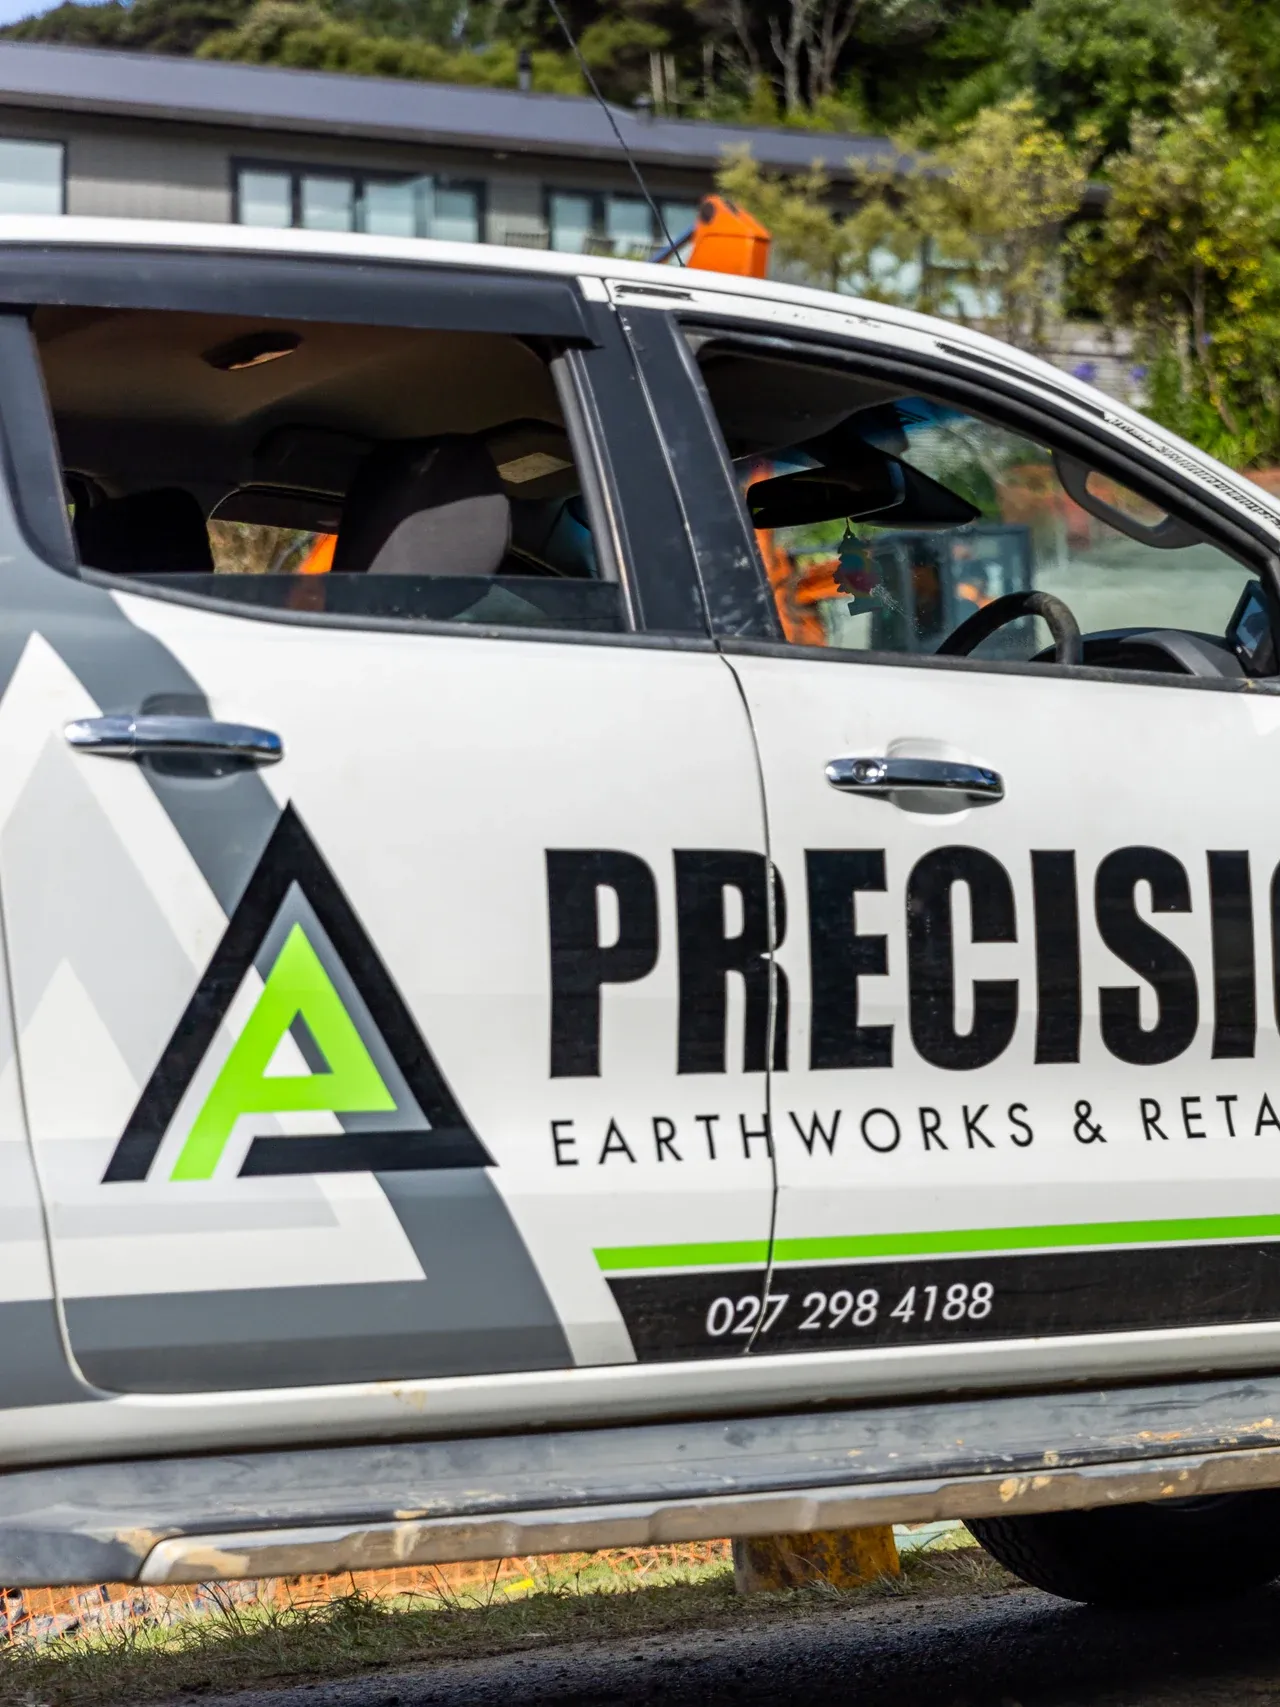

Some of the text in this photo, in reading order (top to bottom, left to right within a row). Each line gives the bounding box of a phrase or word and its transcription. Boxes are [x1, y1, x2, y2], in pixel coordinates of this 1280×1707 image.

[550, 1101, 1034, 1167] EARTHWORKS
[1073, 1099, 1107, 1144] &
[705, 1280, 994, 1337] 027 298 4188
